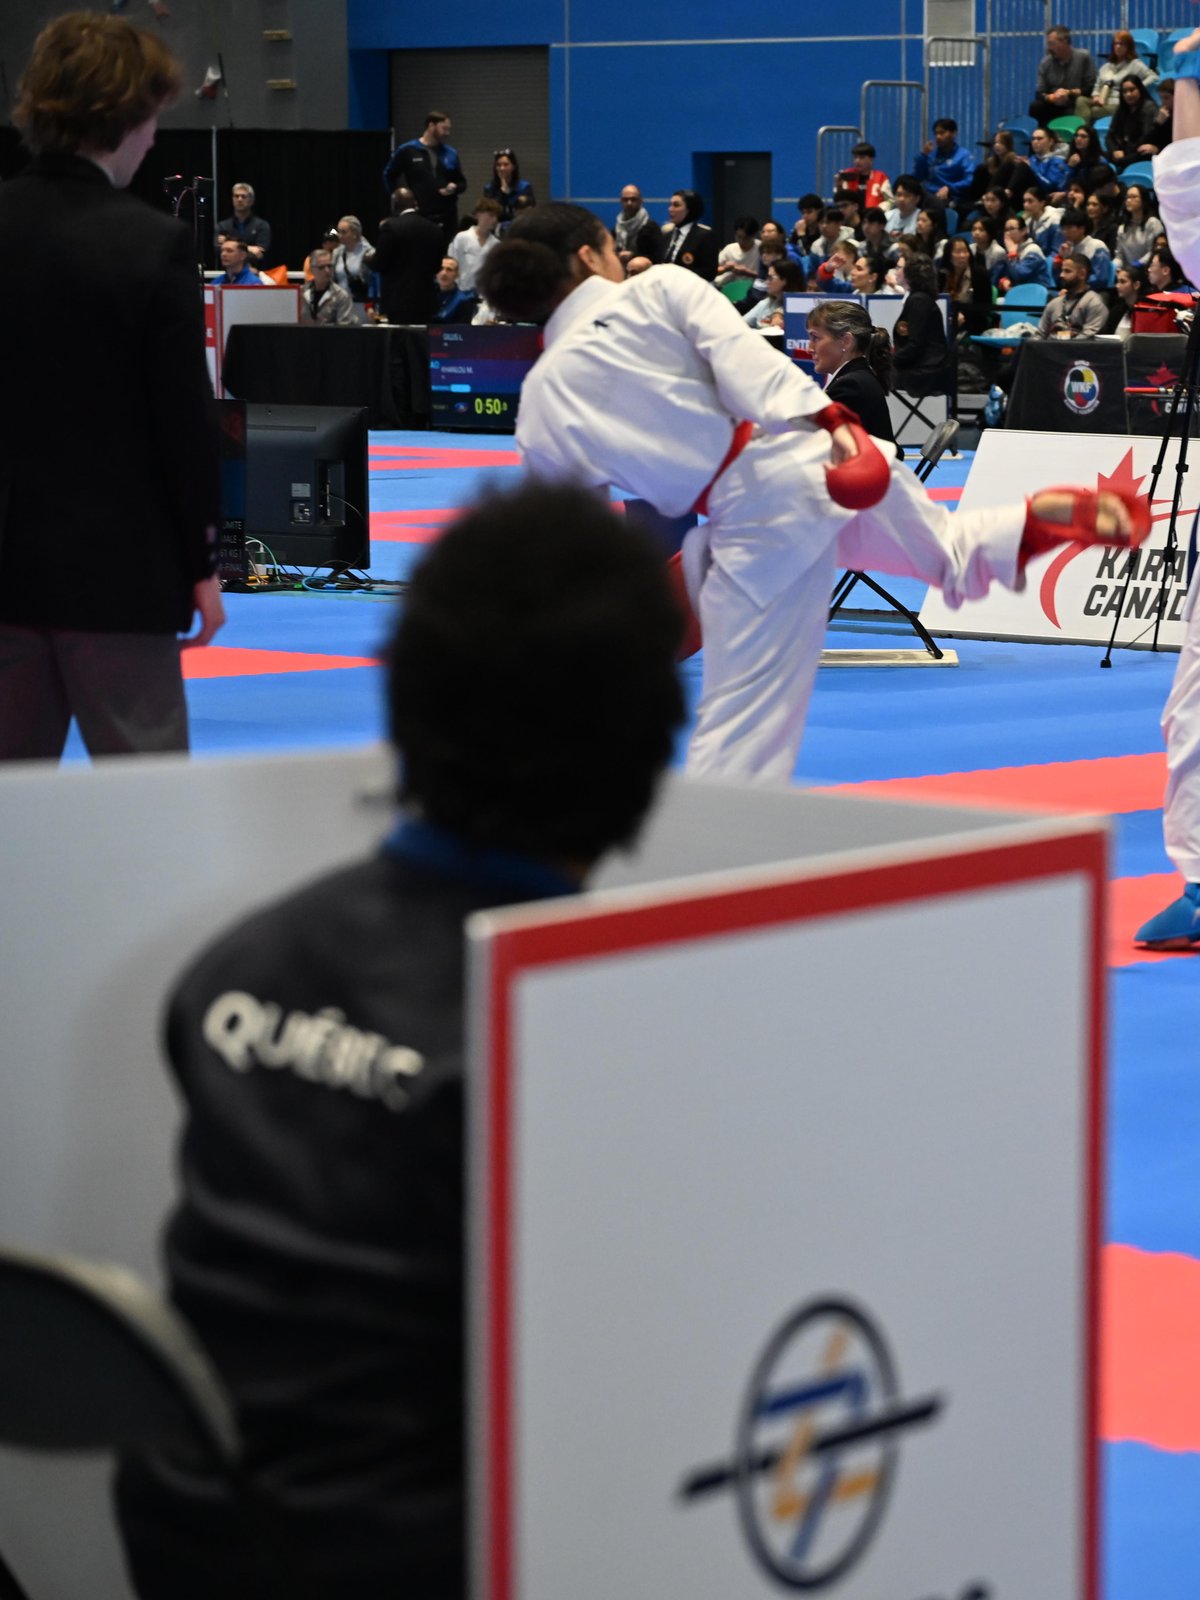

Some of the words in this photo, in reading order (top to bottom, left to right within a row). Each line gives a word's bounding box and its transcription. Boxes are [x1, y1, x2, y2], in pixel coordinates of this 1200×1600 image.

[1071, 381, 1092, 393] WKF
[1096, 546, 1187, 583] KARA
[1083, 585, 1187, 621] CANAD
